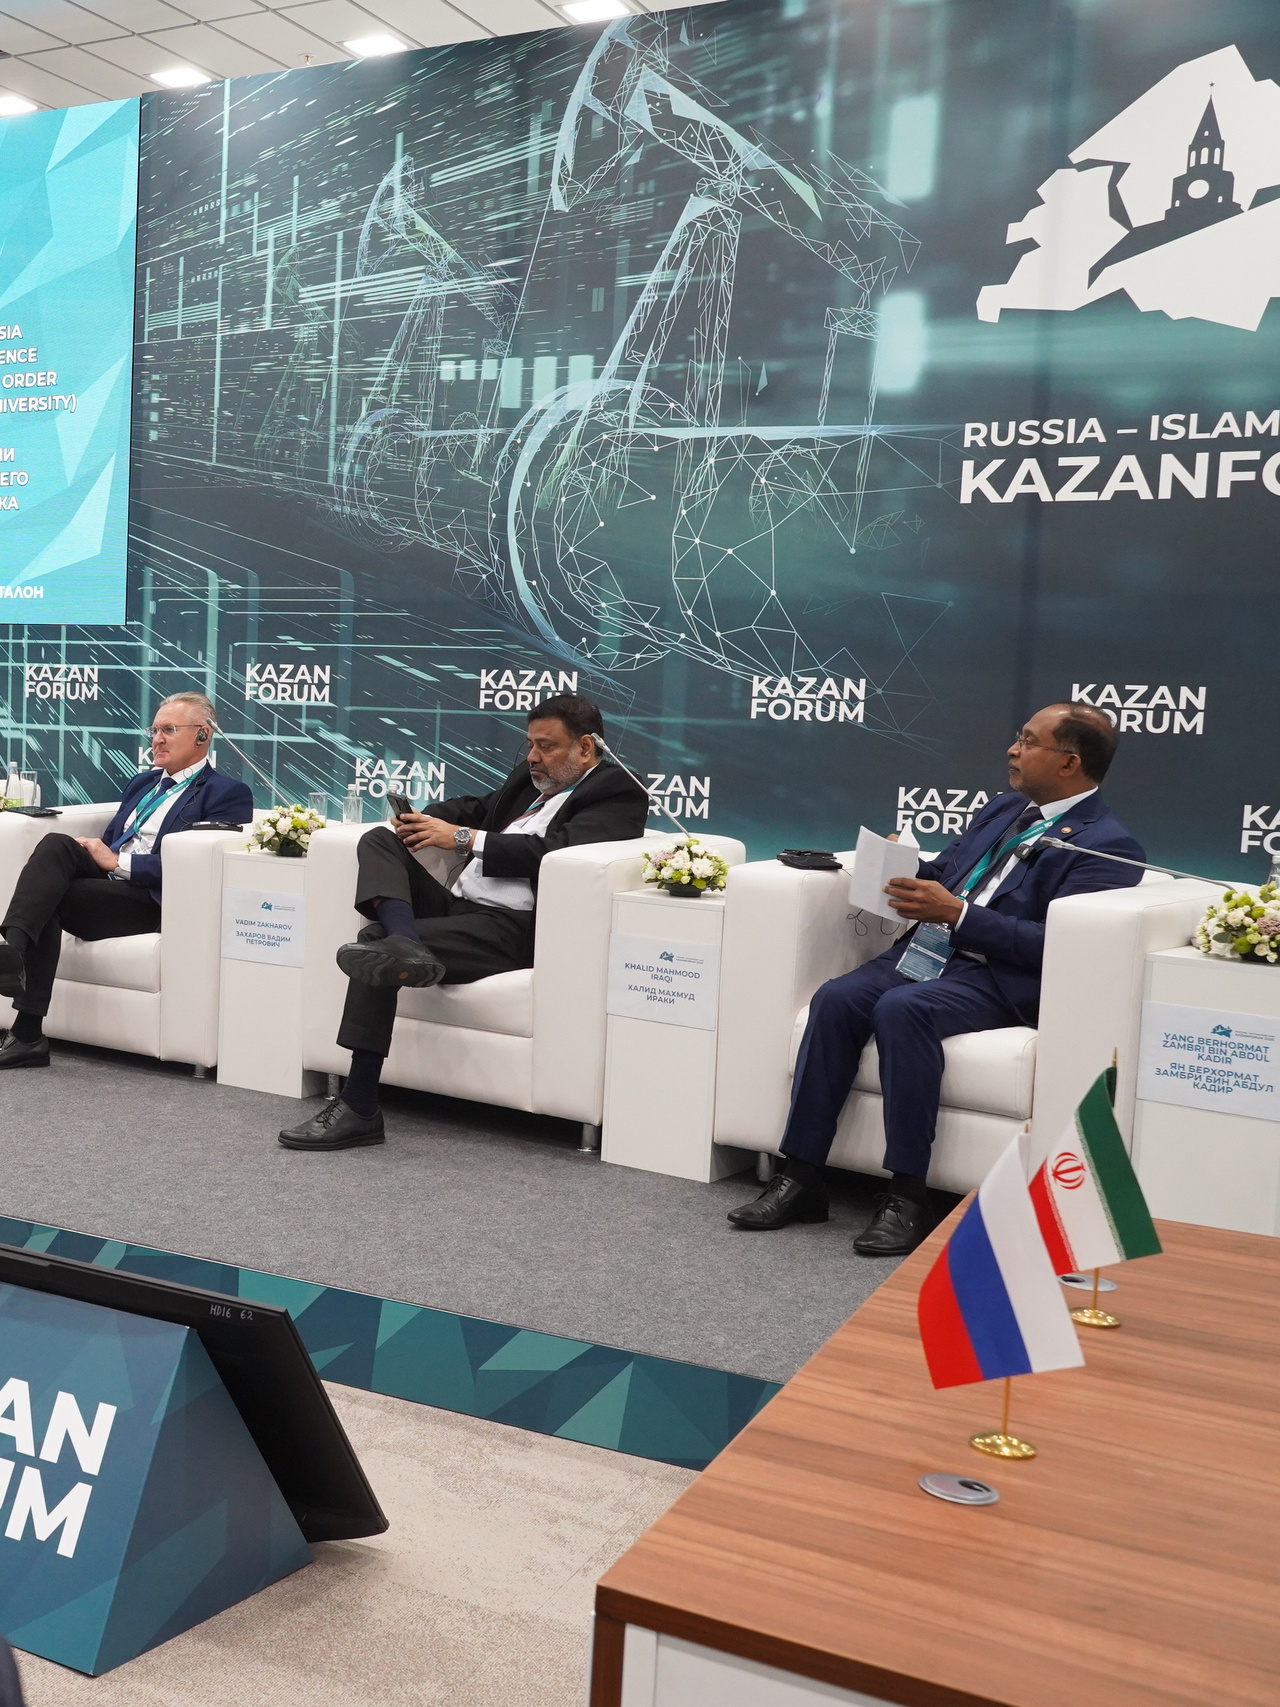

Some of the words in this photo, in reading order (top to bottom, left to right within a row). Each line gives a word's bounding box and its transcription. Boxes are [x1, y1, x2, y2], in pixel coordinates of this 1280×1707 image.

[2, 371, 57, 388] ORDER
[964, 418, 1107, 447] RUSSIA
[25, 664, 98, 682] KAZAN
[246, 663, 330, 684] KAZAN
[480, 669, 578, 691] KAZAN
[25, 681, 98, 700] FORUM
[245, 683, 330, 703] FORUM
[752, 676, 866, 700] KAZAN
[1071, 684, 1206, 710] KAZAN
[751, 698, 865, 722] FORUM
[355, 758, 445, 781] KAZAN
[897, 786, 990, 812] KAZA
[236, 931, 265, 939] ЗАХАРОВ
[257, 922, 292, 930] ZAKHAROV
[246, 939, 280, 947] ПЕТРОВИЧ
[625, 962, 654, 972] KHALID
[657, 967, 700, 979] MAHMOOD
[651, 974, 673, 983] IRAQI
[628, 984, 656, 995] ХАЛИД
[659, 989, 695, 1001] МАХМУД
[647, 995, 675, 1004] ИРАКИ
[1162, 1040, 1205, 1053] ZAMBRI
[1208, 1046, 1227, 1056] BIN
[1231, 1051, 1270, 1062] ABDUL
[1164, 1033, 1194, 1043] YANG
[1198, 1037, 1269, 1054] BERHORMAT
[1198, 1053, 1232, 1065] KADIR
[1155, 1068, 1202, 1081] ЗАМБРИ
[1206, 1075, 1229, 1085] БИН
[1233, 1080, 1274, 1093] АБДУЛ
[1170, 1062, 1185, 1071] ЯН
[1189, 1065, 1259, 1082] БЕРХОРМАТ
[1193, 1082, 1233, 1094] КАДИР
[240, 1310, 253, 1320] 62
